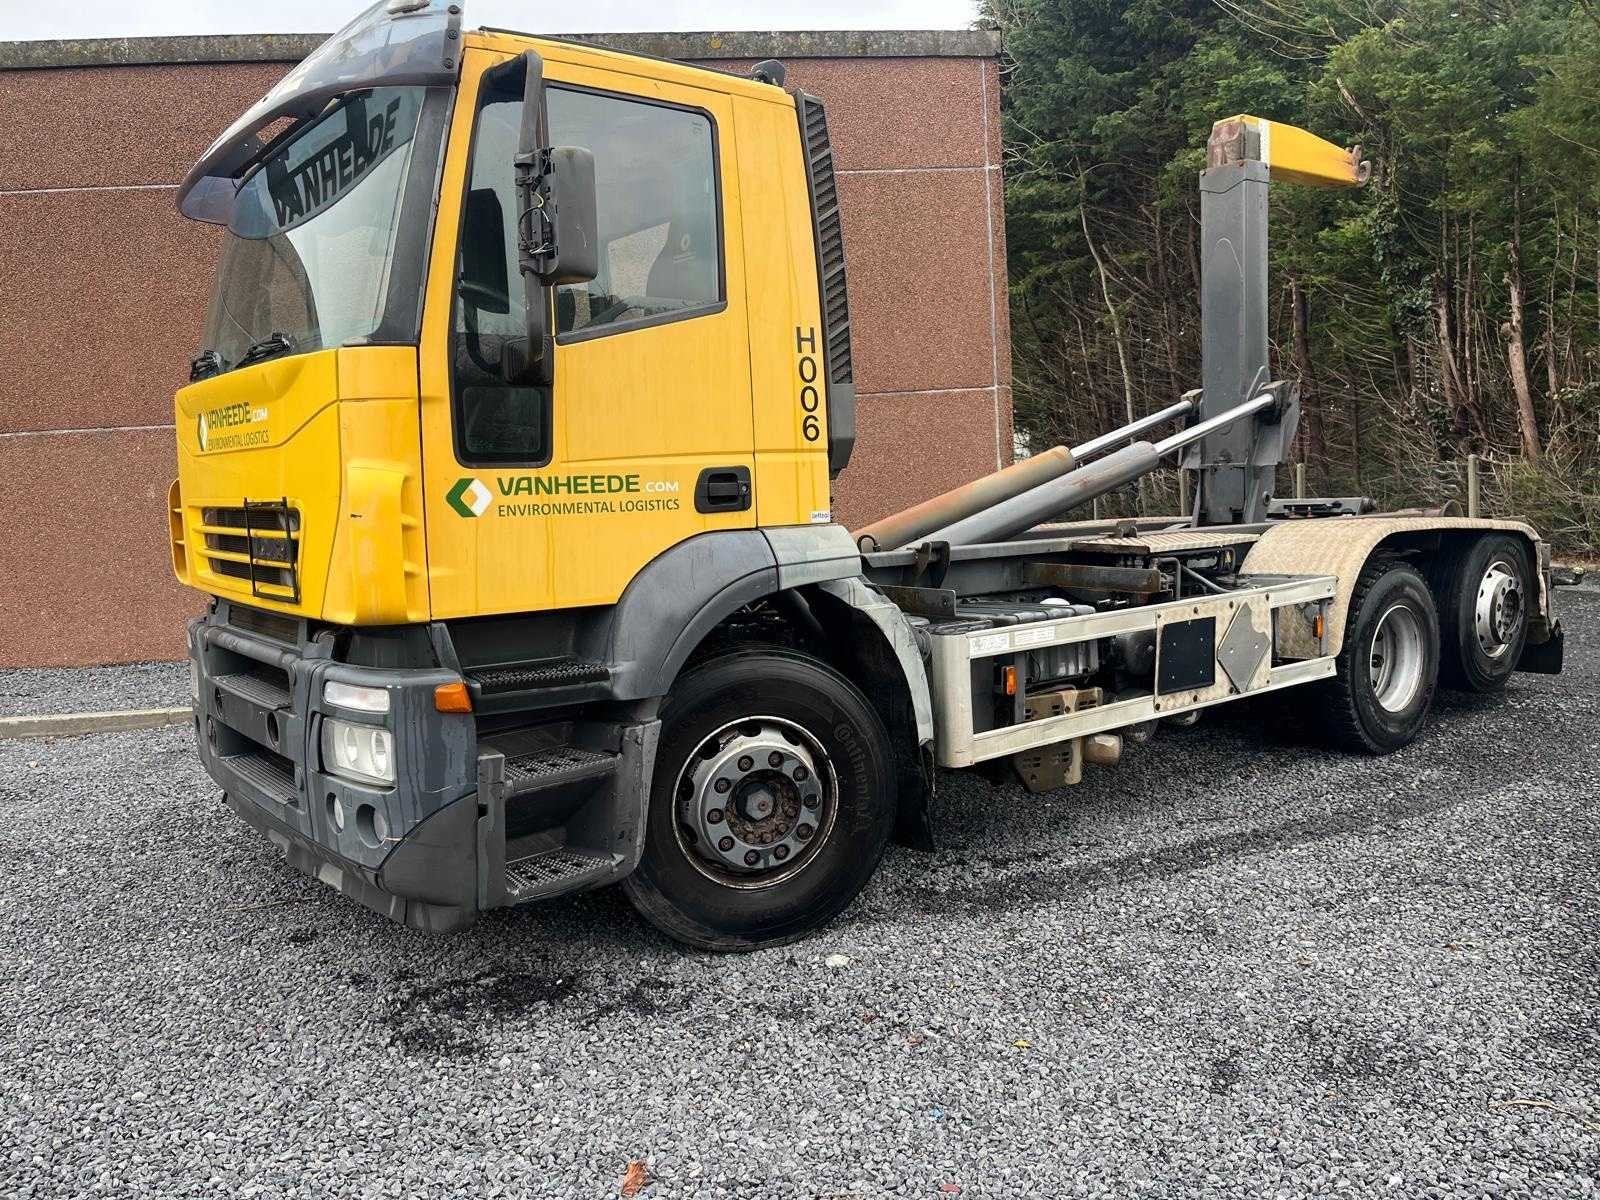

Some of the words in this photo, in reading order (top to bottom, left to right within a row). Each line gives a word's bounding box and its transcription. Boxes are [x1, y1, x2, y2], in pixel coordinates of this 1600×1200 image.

[796, 326, 820, 442] H006
[498, 501, 617, 517] ENVIRONMENTAL
[619, 498, 681, 513] LOGISTICS
